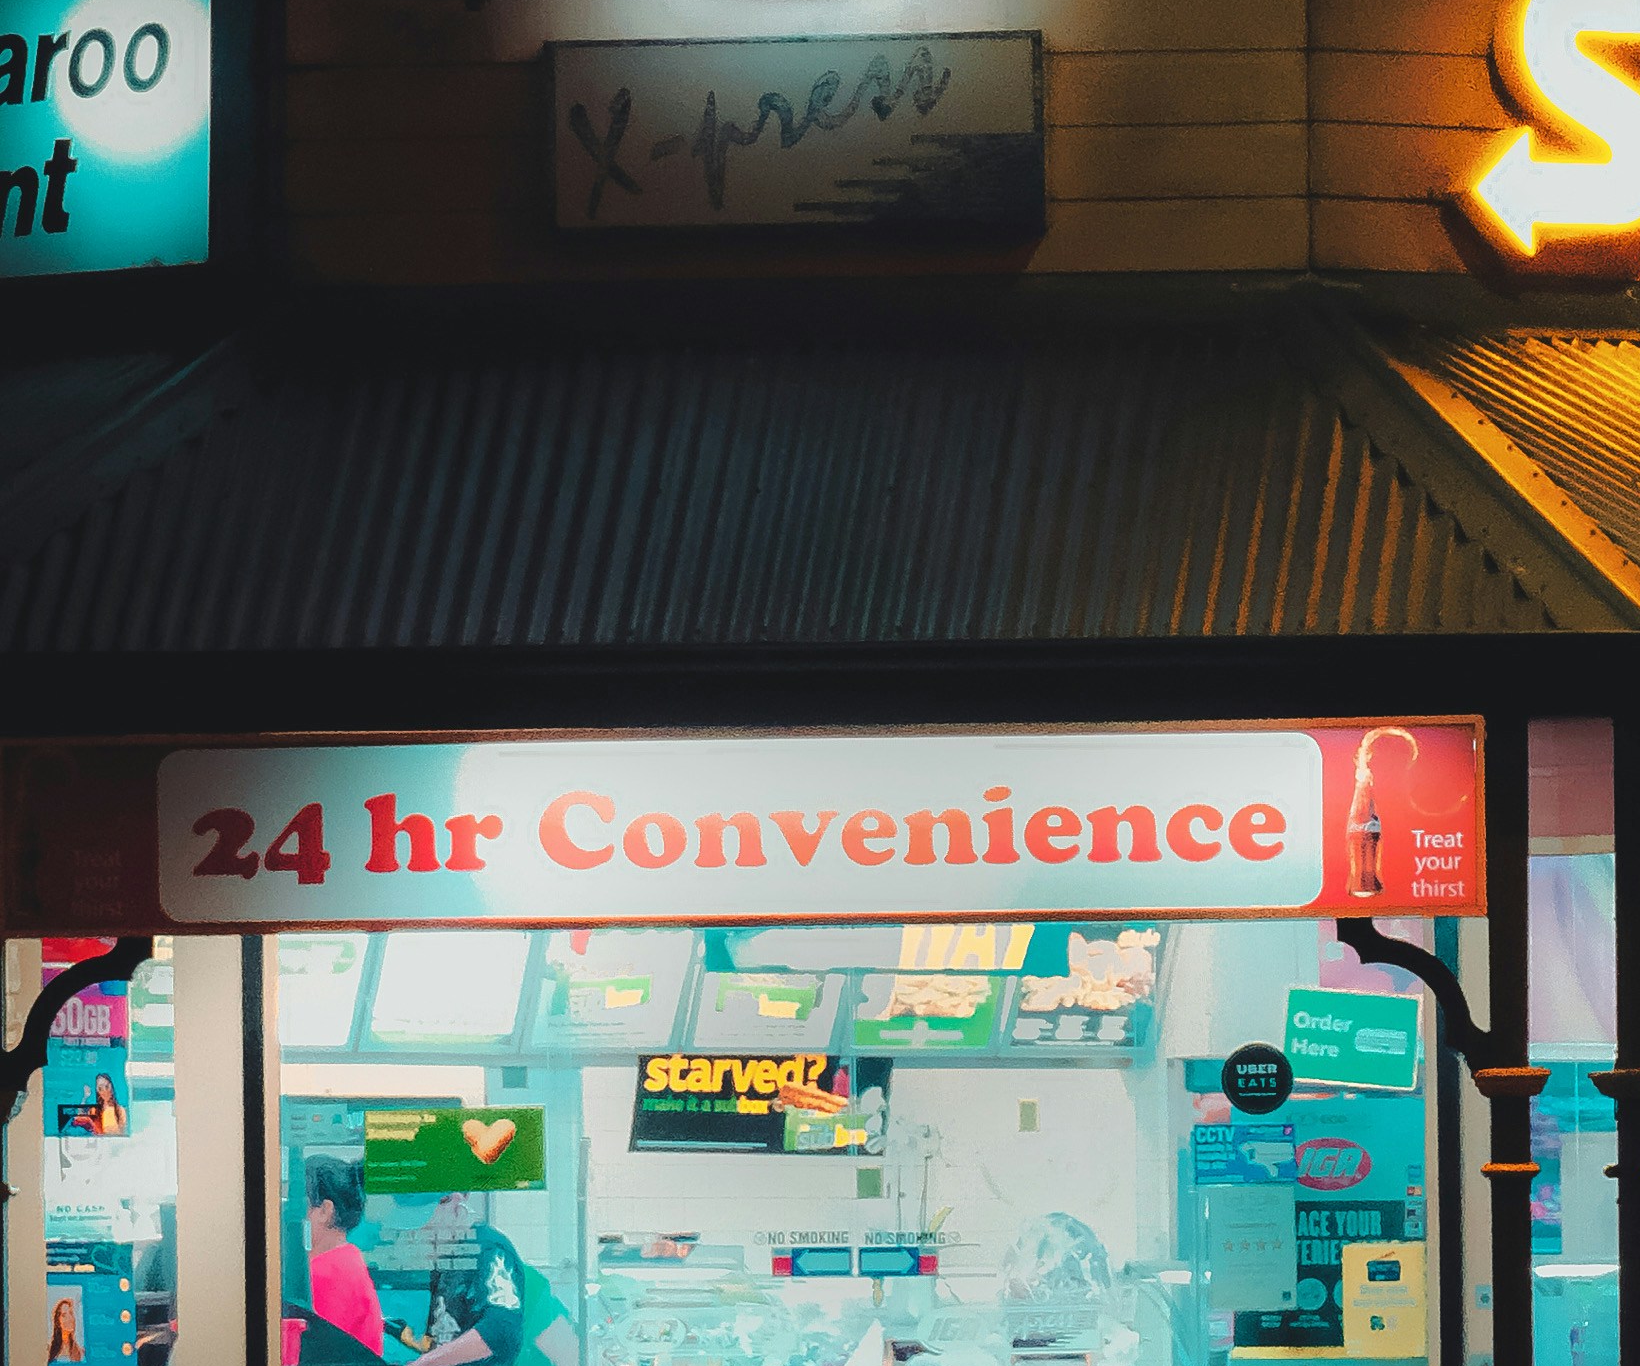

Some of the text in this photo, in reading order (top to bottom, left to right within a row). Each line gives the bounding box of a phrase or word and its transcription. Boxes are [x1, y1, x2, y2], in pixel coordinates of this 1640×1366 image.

[569, 44, 953, 220] X-press
[191, 785, 1288, 885] 24 hr Convenience
[1411, 829, 1465, 849] Treat
[1414, 854, 1463, 876] your
[1411, 879, 1466, 899] thirst
[1293, 1010, 1353, 1033] Order
[1290, 1038, 1341, 1058] Here
[643, 1052, 828, 1094] starved?
[1236, 1063, 1278, 1075] UBER
[1237, 1077, 1278, 1089] EATS
[1195, 1126, 1235, 1144] CCTV
[1300, 1147, 1365, 1179] IGA
[1334, 1210, 1382, 1237] YOUR
[767, 1230, 849, 1245] NO SMOKING
